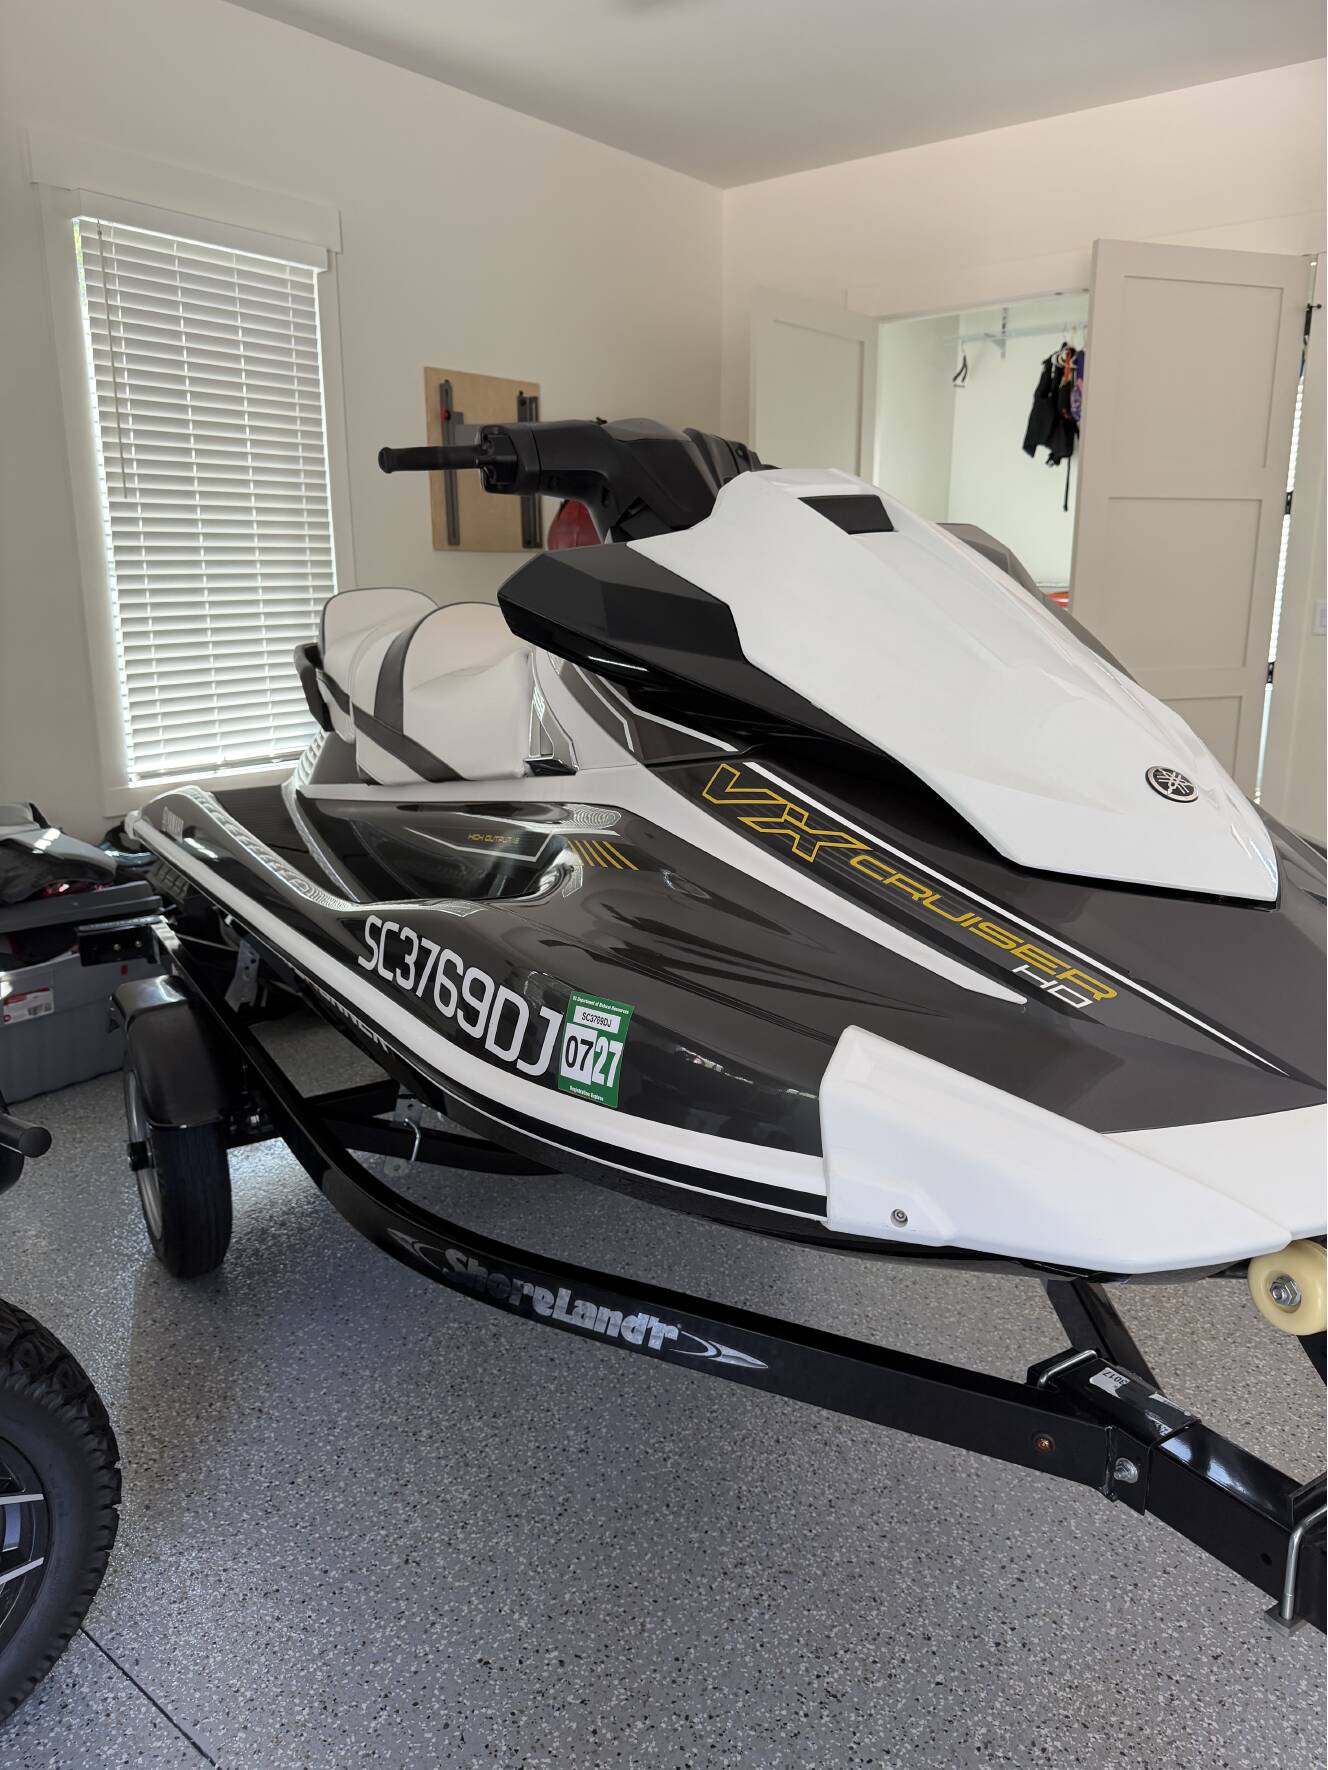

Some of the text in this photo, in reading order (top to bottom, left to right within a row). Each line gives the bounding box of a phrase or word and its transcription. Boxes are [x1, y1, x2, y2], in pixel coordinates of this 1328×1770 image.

[702, 763, 1118, 1003] VX CRUISER
[357, 914, 564, 1077] SC3769DJ
[1011, 964, 1094, 1009] HO
[565, 1035, 624, 1088] 07 27
